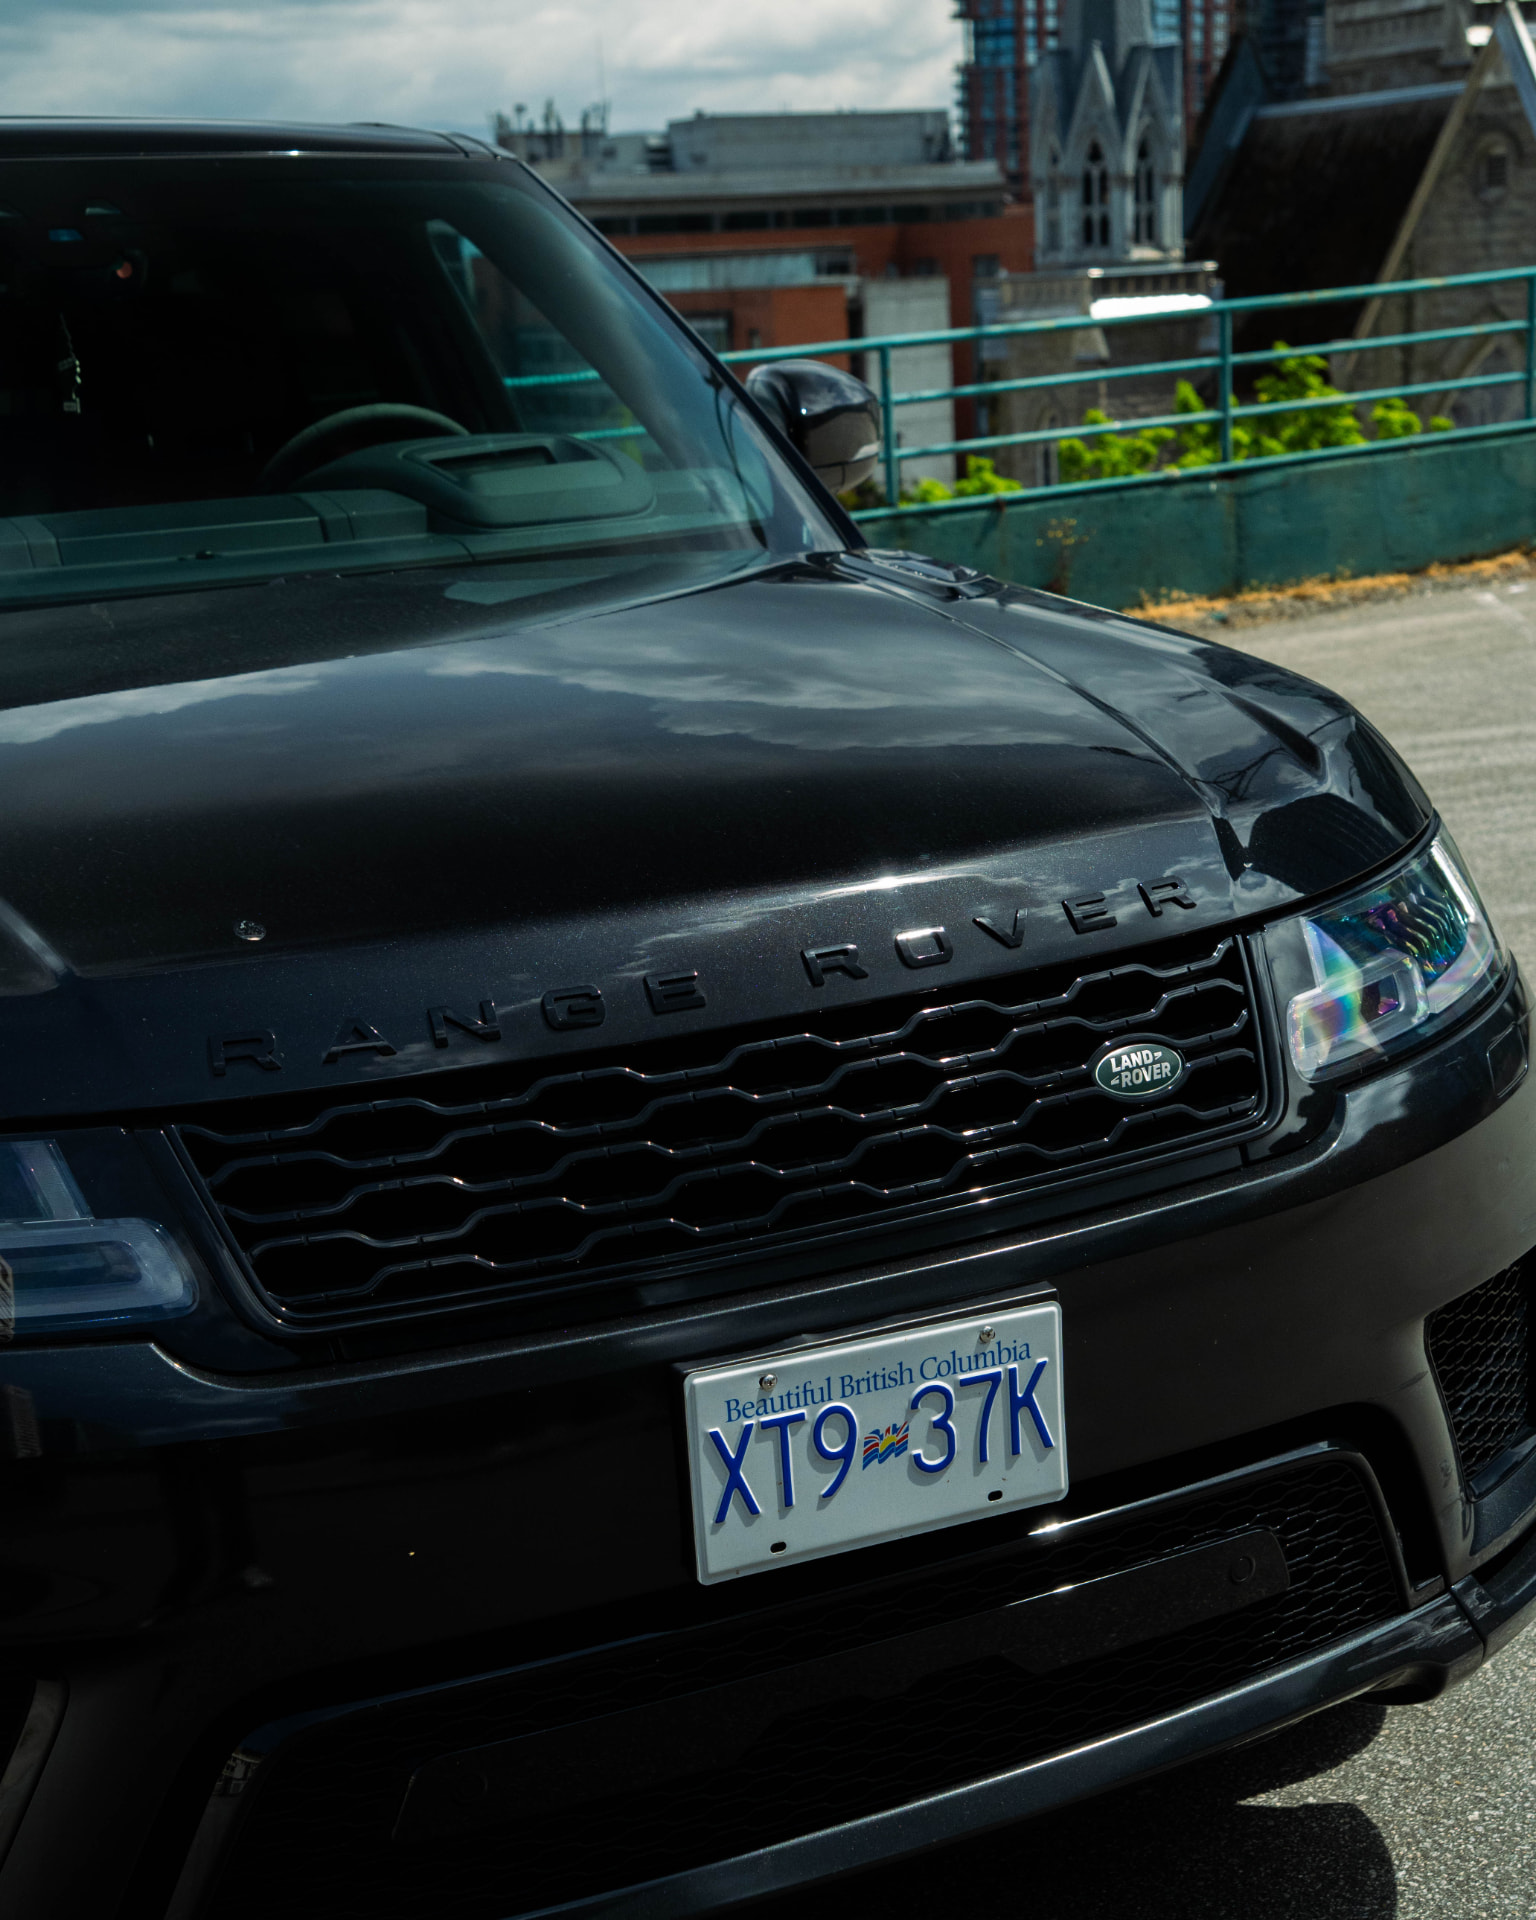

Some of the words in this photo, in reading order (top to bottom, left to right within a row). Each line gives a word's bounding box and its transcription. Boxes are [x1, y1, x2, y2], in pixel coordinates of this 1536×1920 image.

[208, 969, 706, 1076] RANGE
[800, 876, 1196, 987] ROVER
[1110, 1049, 1153, 1073] LAND
[1121, 1062, 1171, 1088] ROVER
[725, 1377, 833, 1423] Beautiful
[839, 1363, 914, 1399] British
[919, 1341, 1031, 1379] Columbia
[708, 1403, 857, 1524] XT9
[910, 1358, 1054, 1474] 37K
